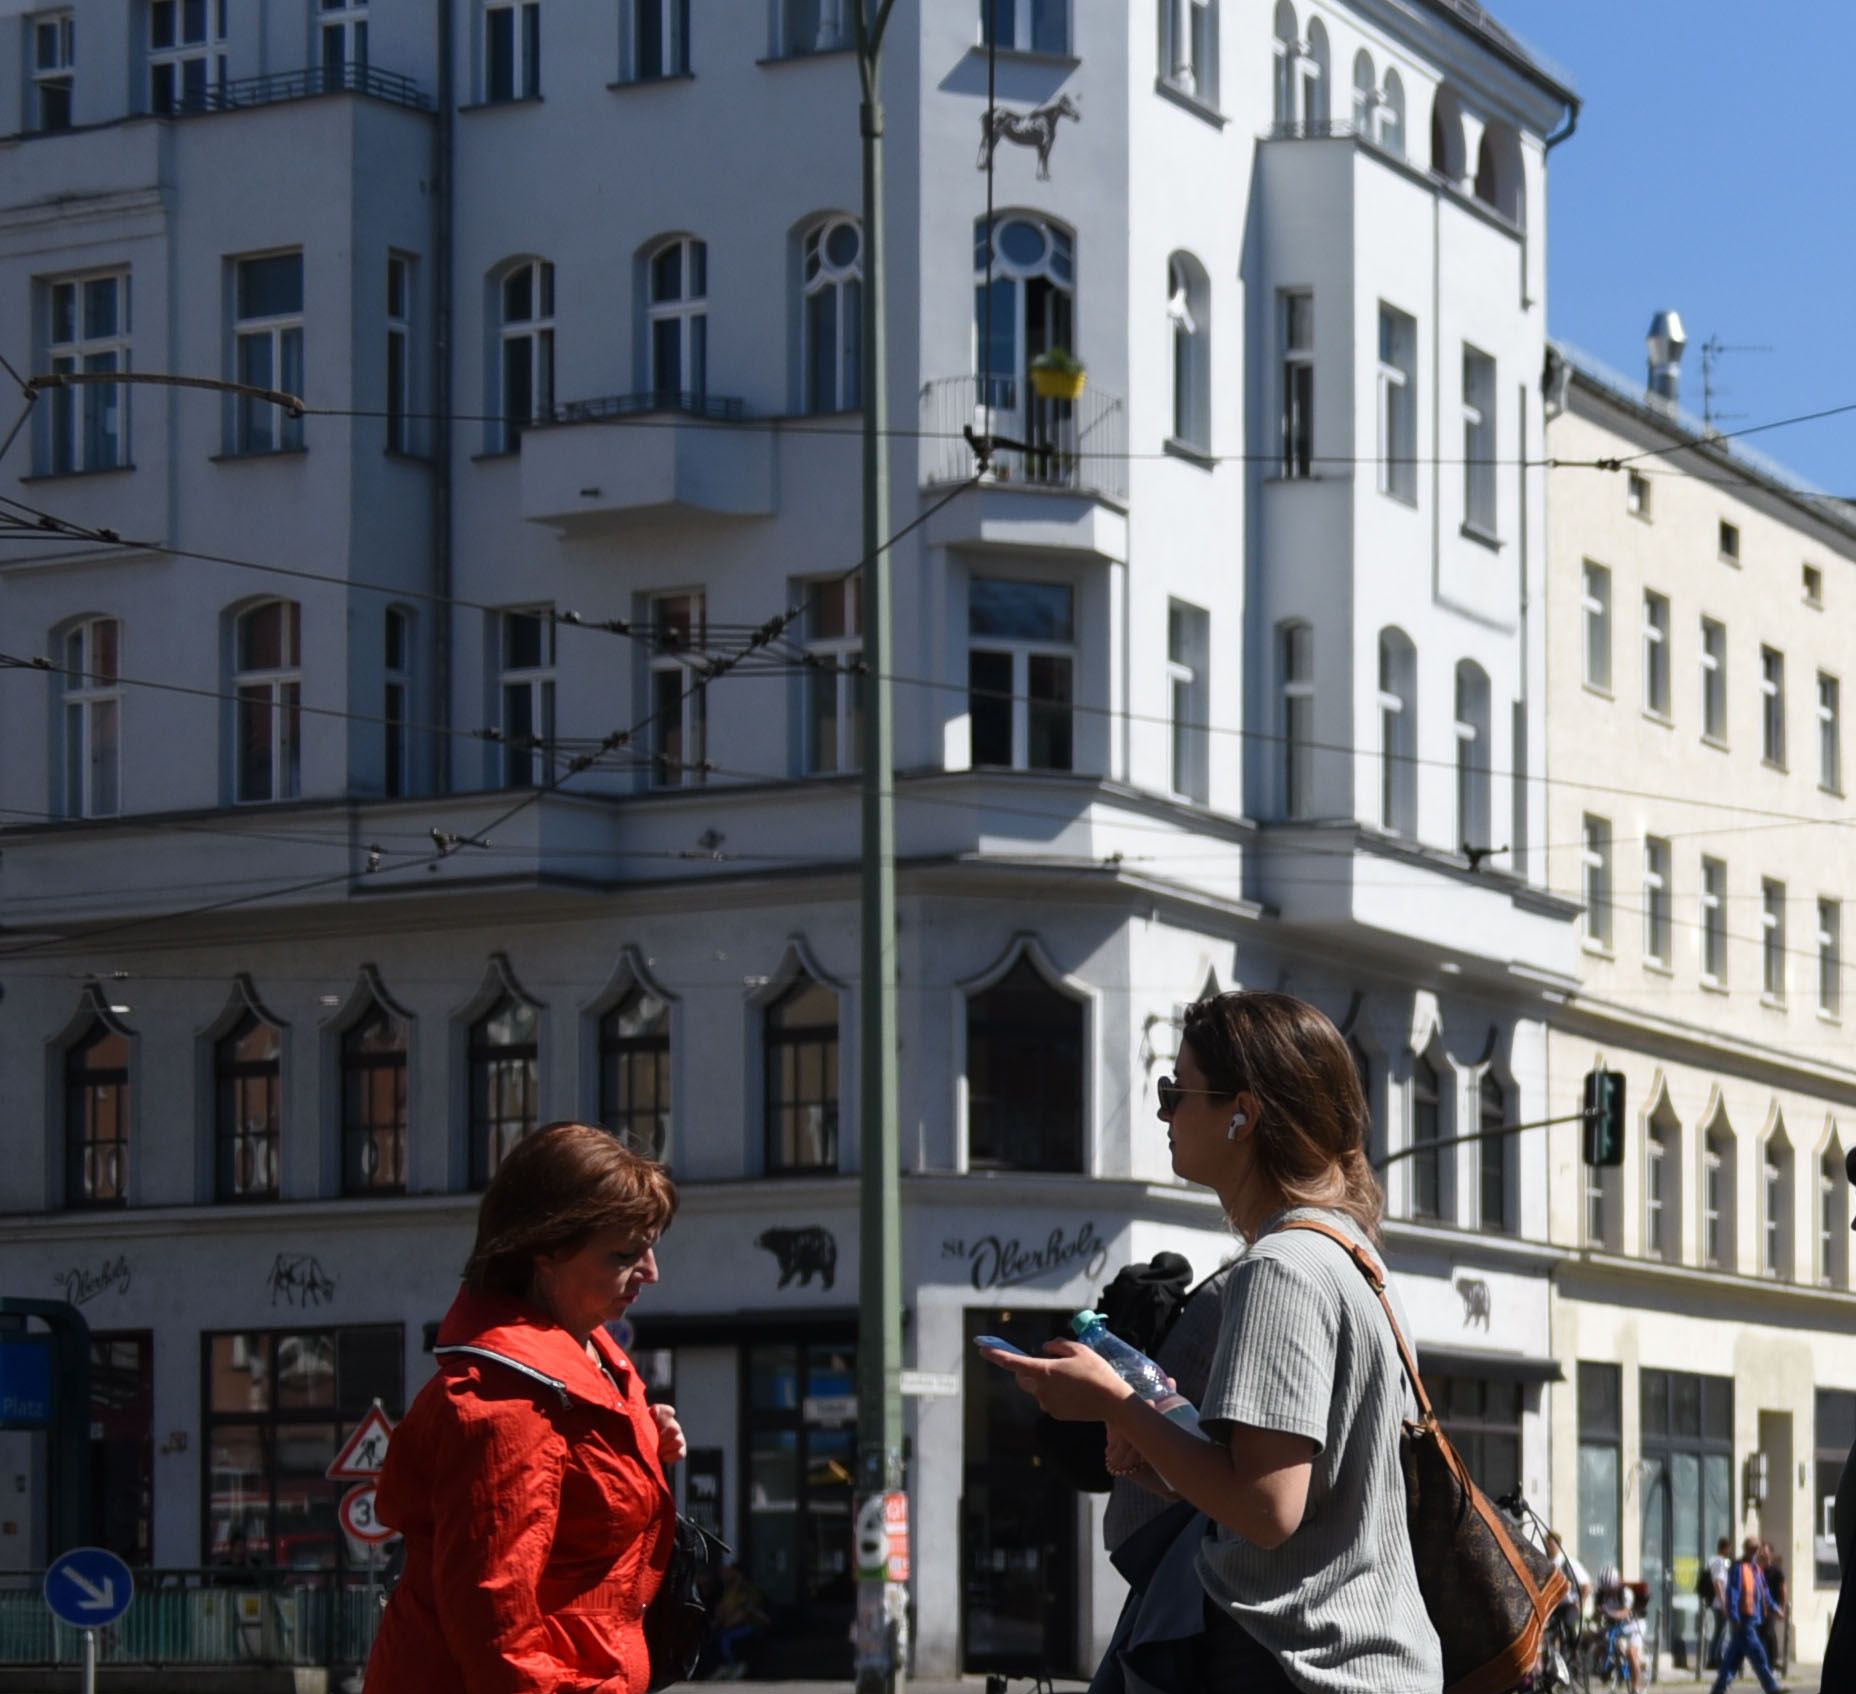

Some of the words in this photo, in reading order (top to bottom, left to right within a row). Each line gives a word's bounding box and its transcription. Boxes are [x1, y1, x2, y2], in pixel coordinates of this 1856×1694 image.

[968, 1221, 1109, 1292] Oberholz
[2, 1397, 45, 1417] Platz
[354, 1498, 372, 1527] 3
